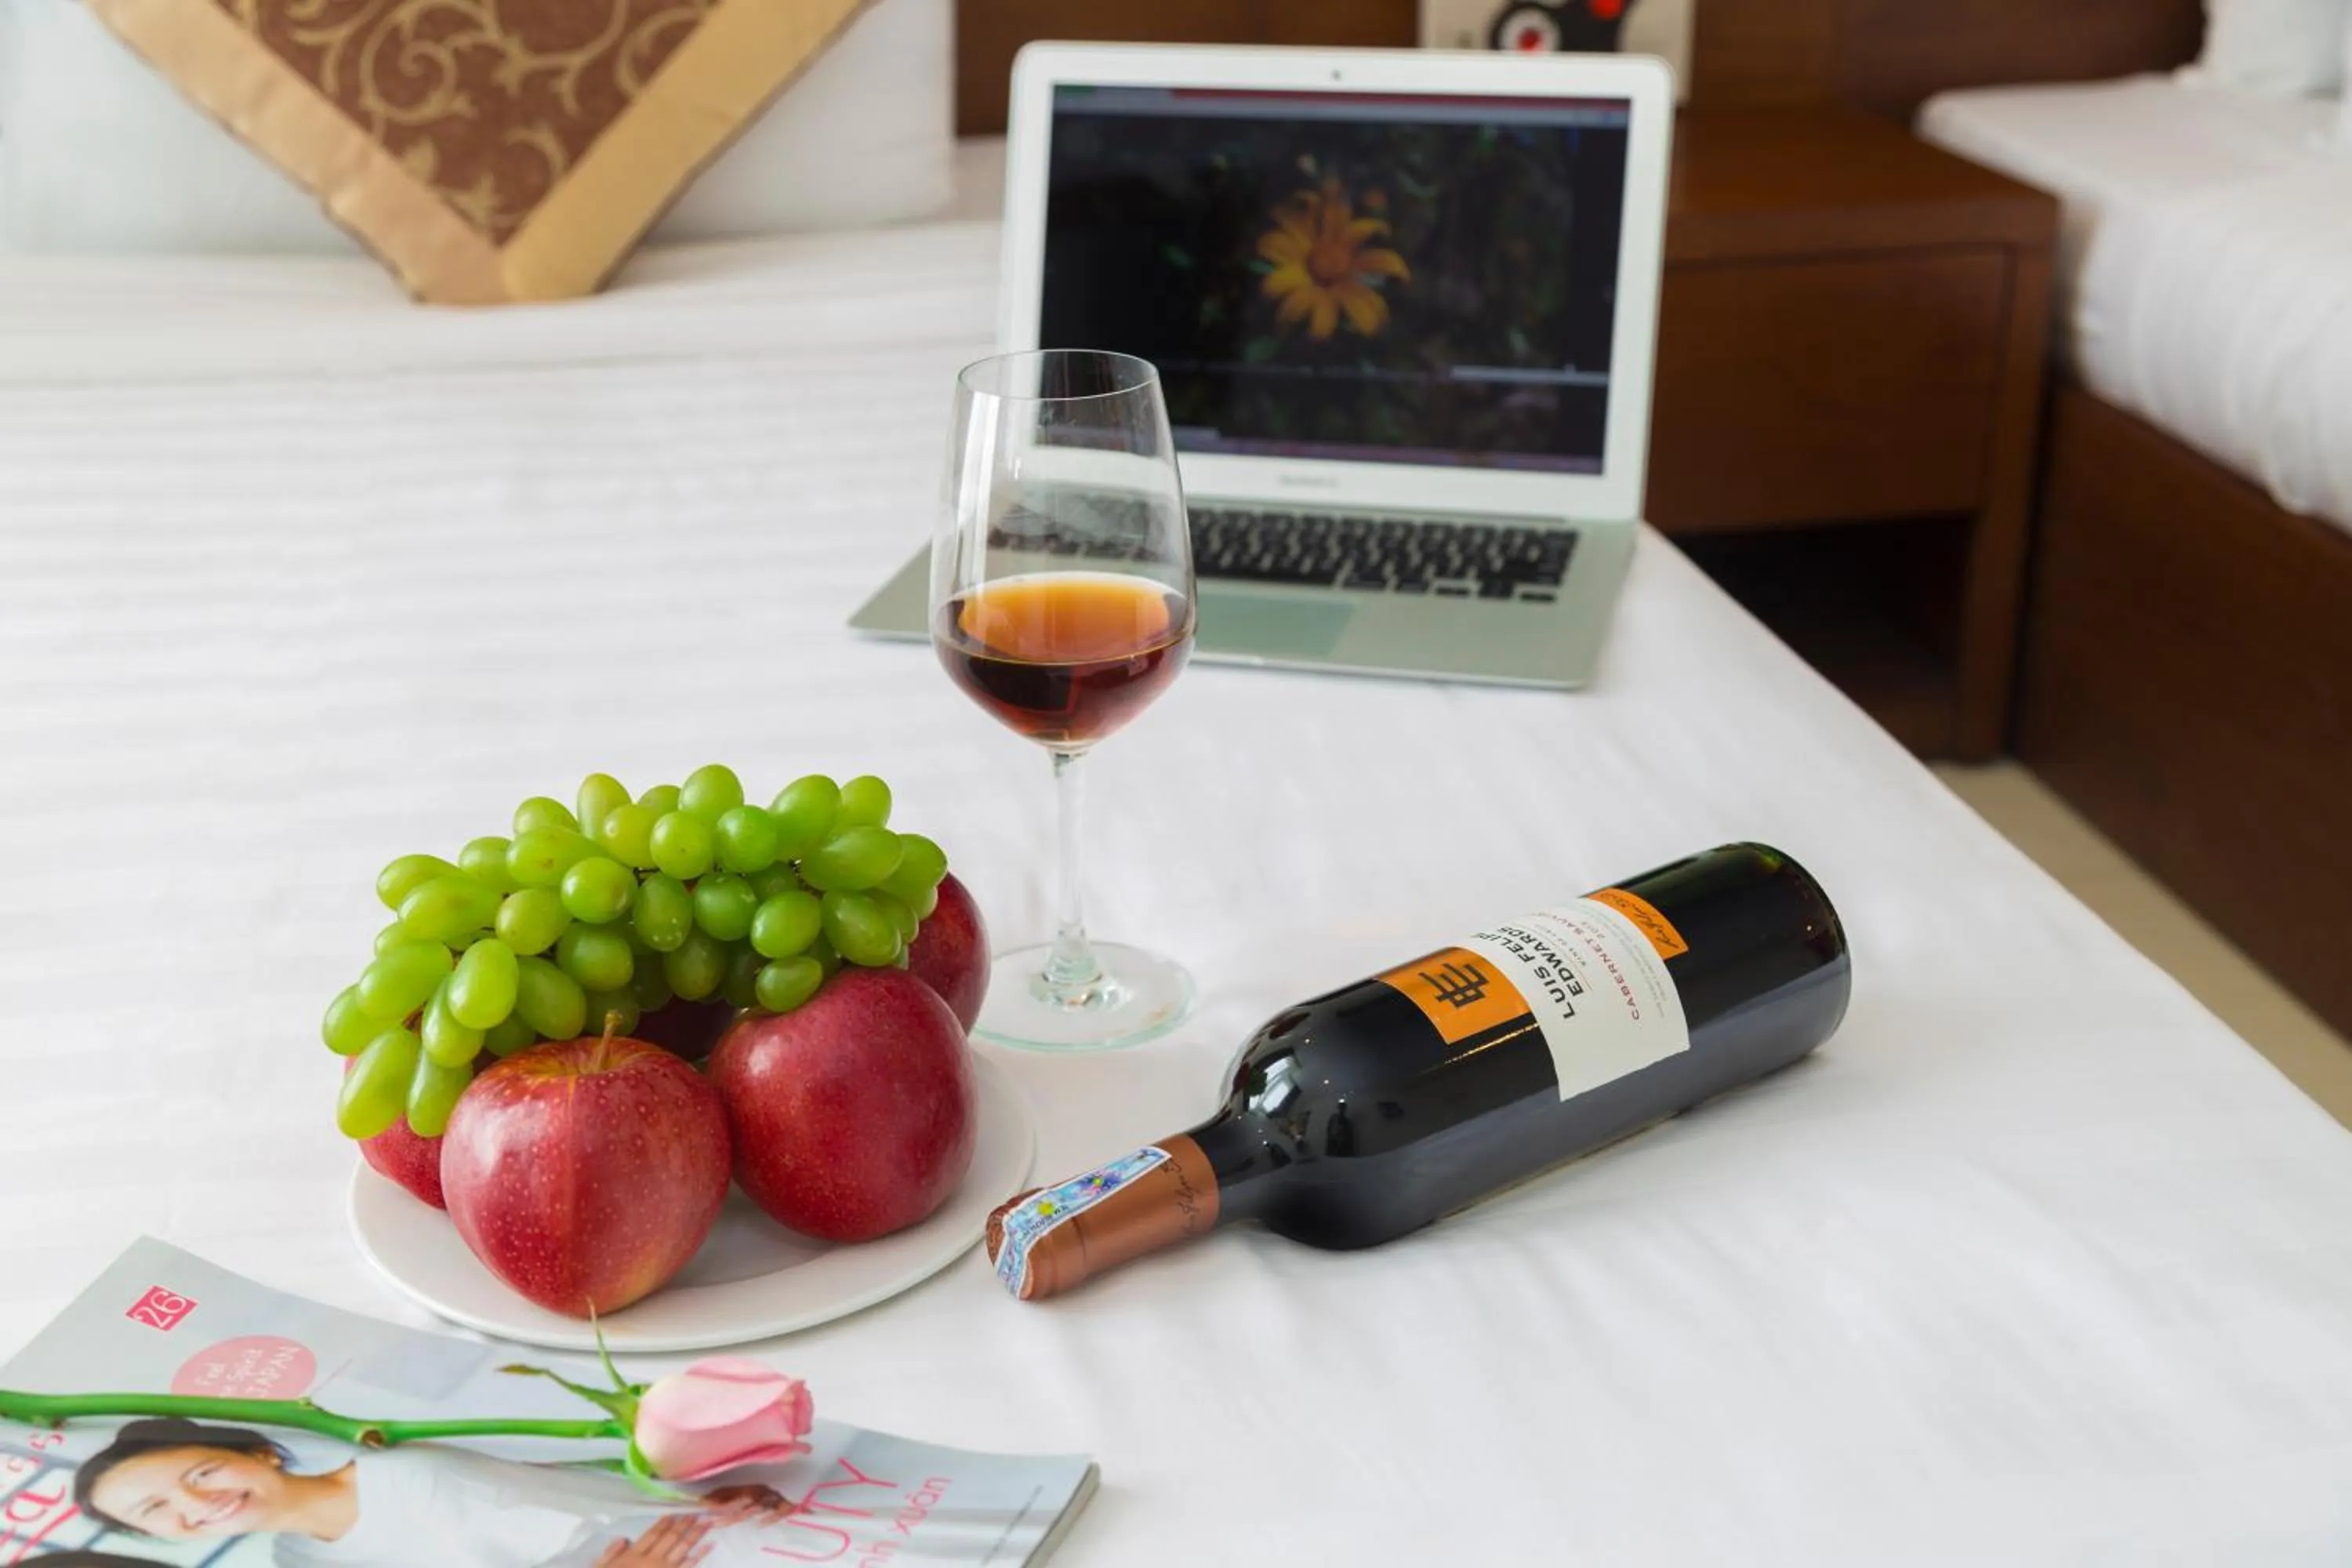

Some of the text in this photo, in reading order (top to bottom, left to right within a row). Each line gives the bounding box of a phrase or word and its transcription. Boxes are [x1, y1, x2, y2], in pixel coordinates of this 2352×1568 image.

[1497, 927, 1584, 997] EDWARDS
[1584, 938, 1640, 1021] CABERNET
[1534, 967, 1575, 1020] LUIS
[132, 1290, 187, 1329] 26
